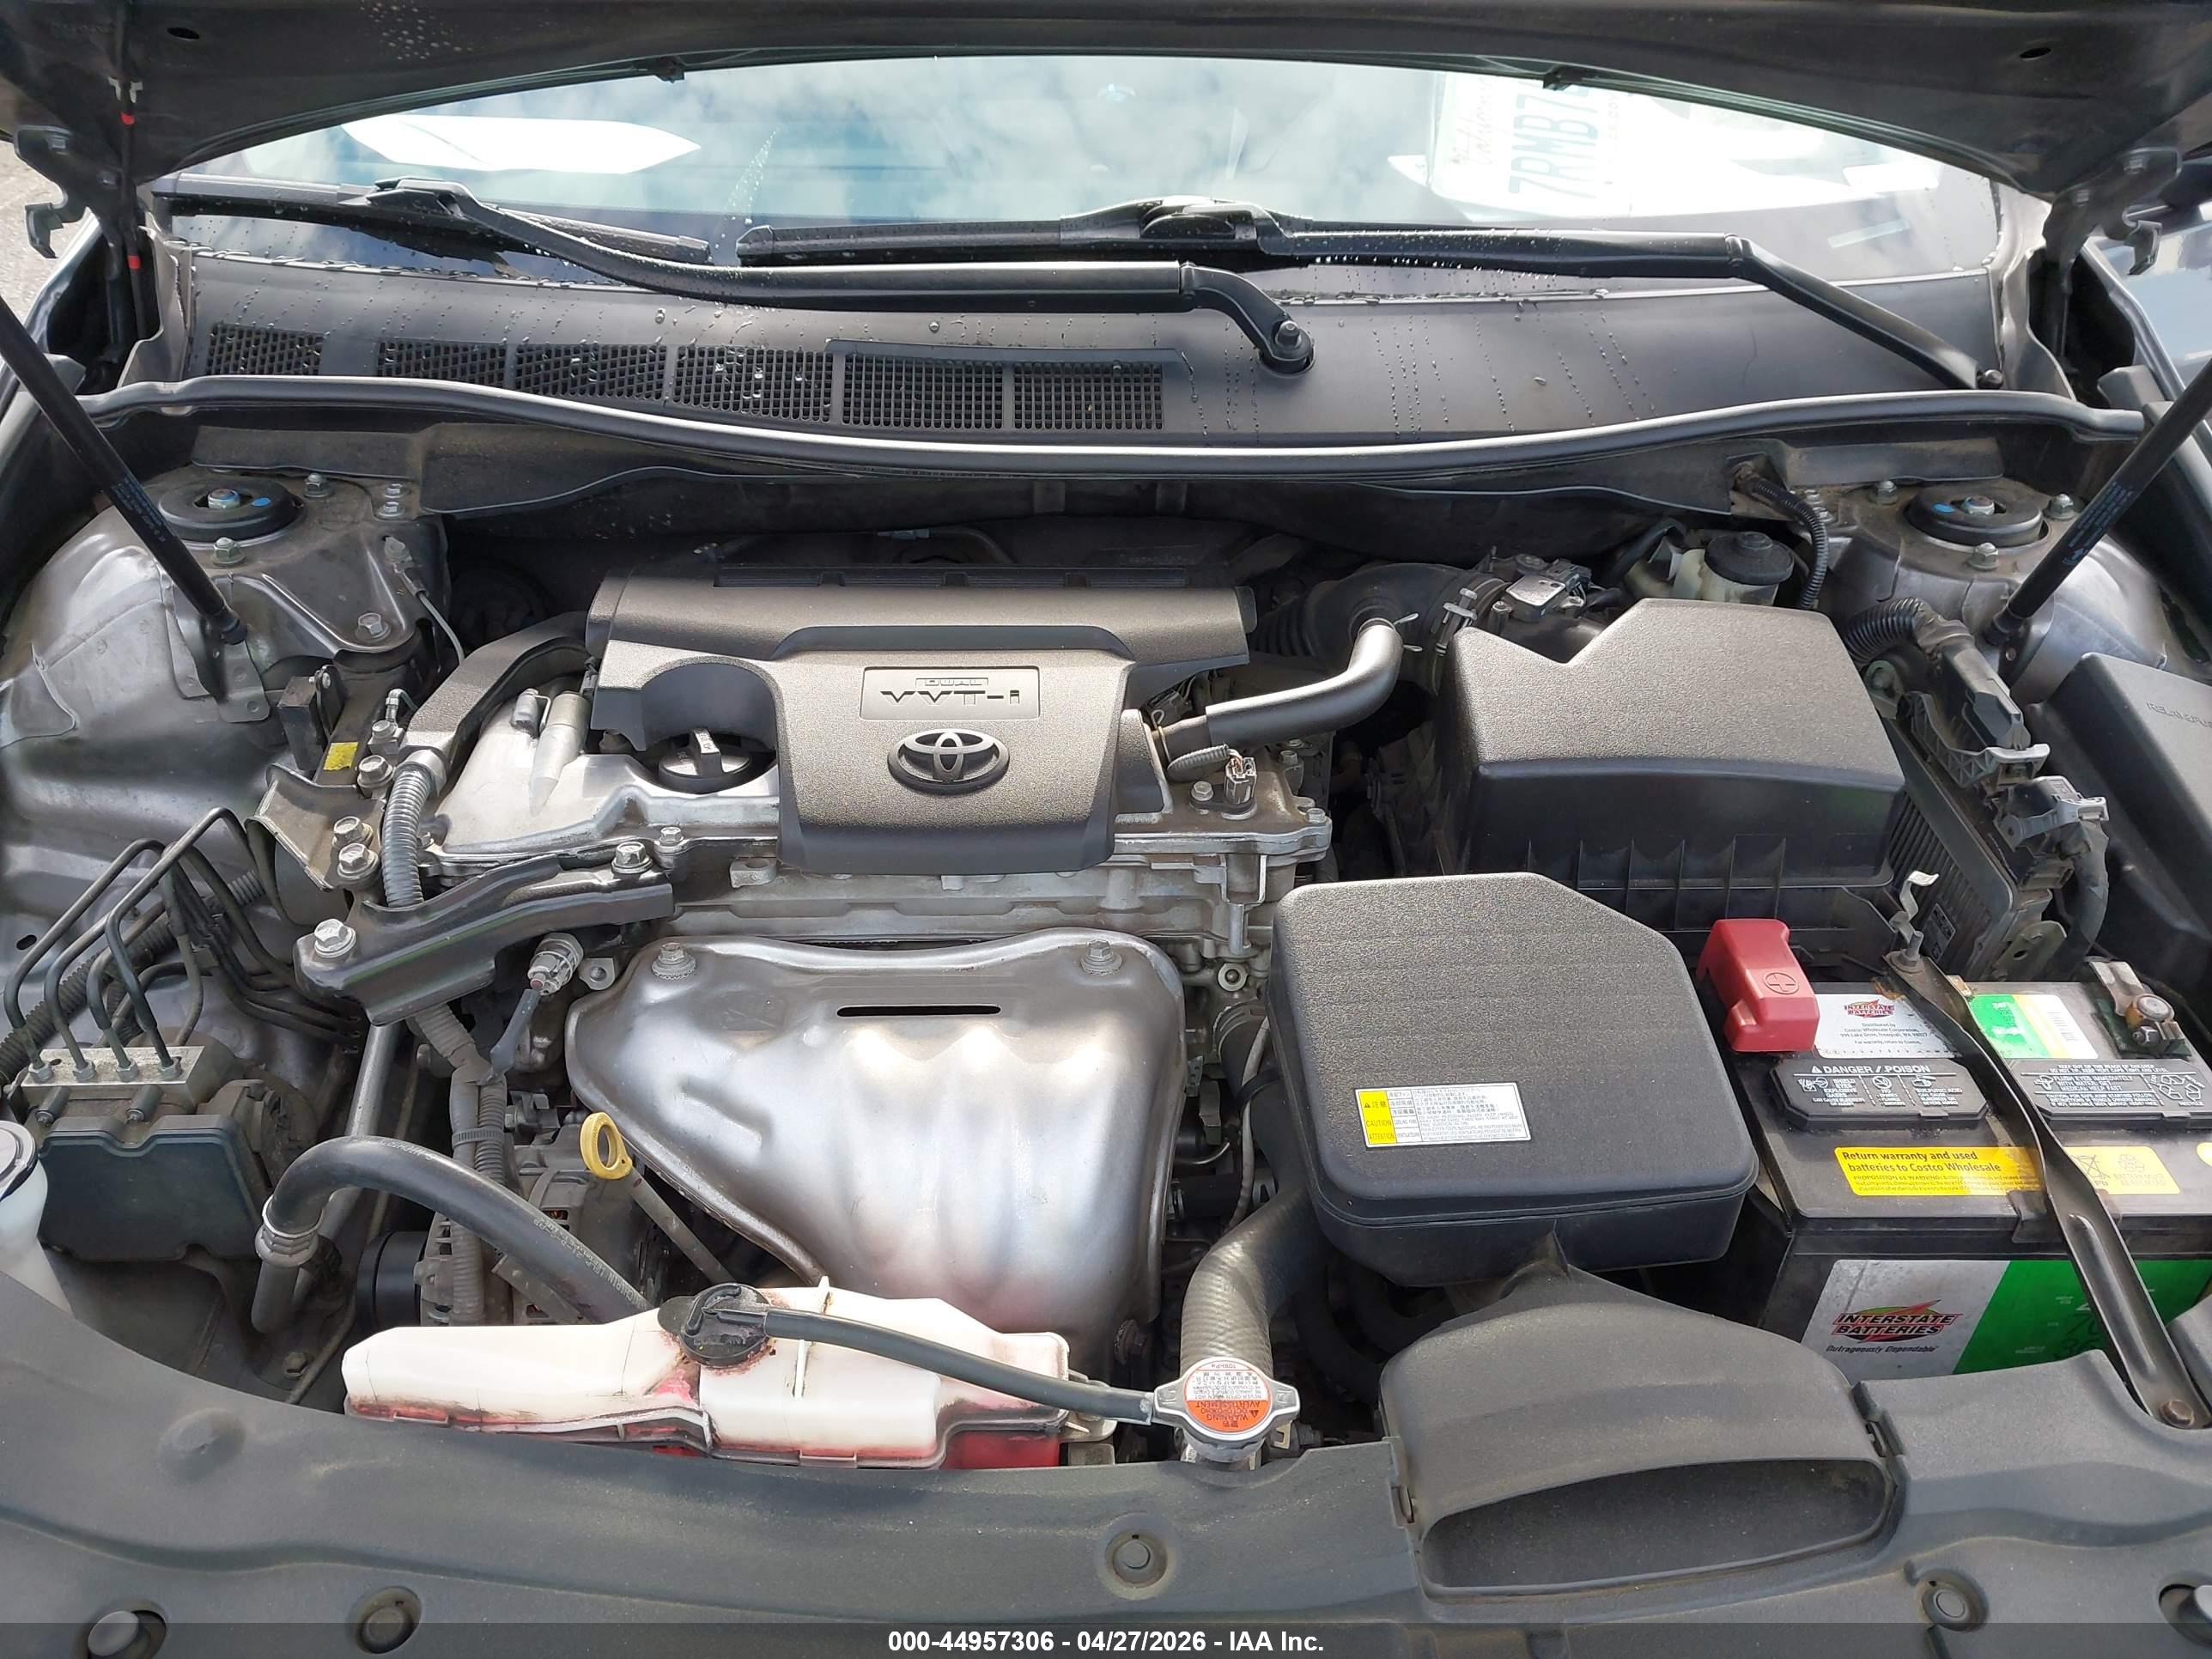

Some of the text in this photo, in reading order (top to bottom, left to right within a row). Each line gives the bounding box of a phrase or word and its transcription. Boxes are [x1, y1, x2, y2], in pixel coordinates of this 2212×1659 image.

[1884, 1065, 1931, 1073] POISON
[1843, 1152, 1978, 1163] Return warranty and used
[1849, 1163, 1895, 1172] batteries
[1909, 1163, 1942, 1171] Costco
[1944, 1163, 2001, 1172] Wholesale
[1838, 1315, 1954, 1324] INTERSTATE
[1837, 1325, 1941, 1334] BATTERIES
[1826, 1346, 1882, 1354] Outrageously
